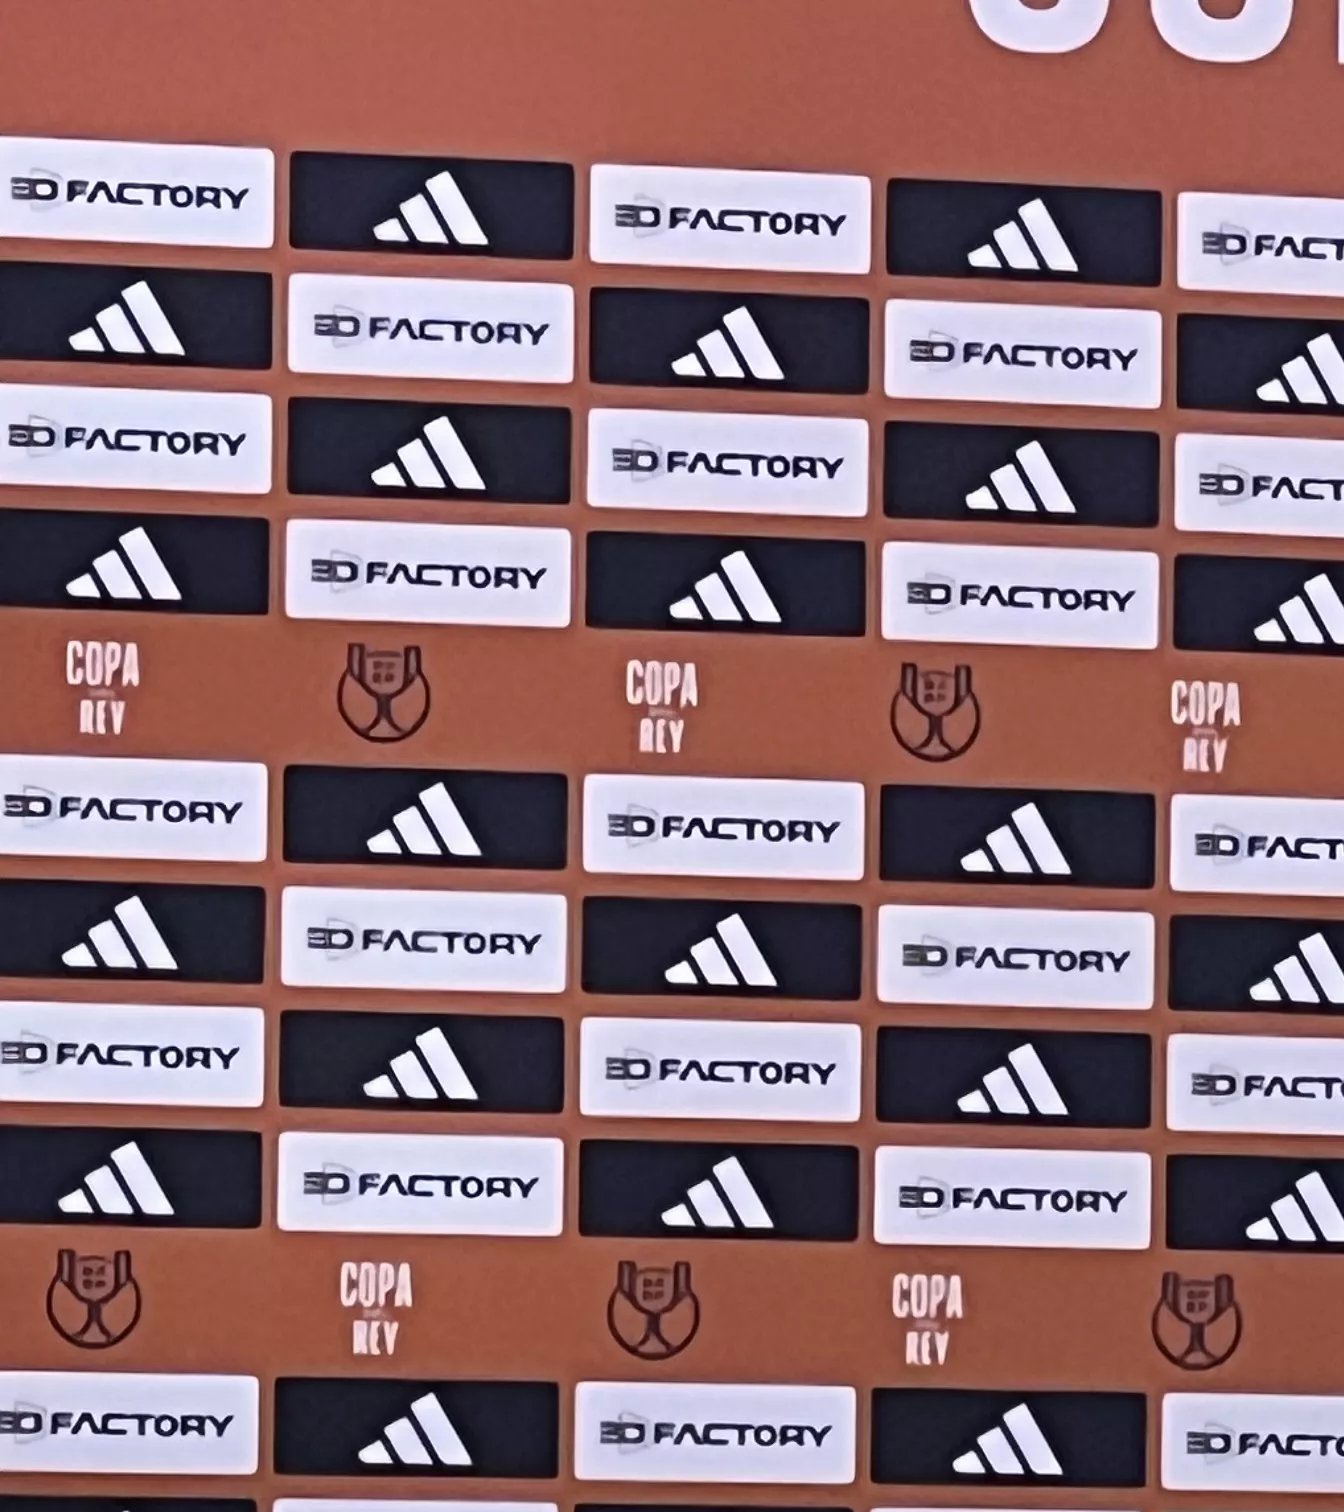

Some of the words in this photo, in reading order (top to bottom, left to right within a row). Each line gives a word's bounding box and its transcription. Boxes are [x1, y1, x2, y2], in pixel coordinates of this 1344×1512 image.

[67, 180, 249, 209] FACTORY
[669, 207, 846, 236] FACTORY
[369, 317, 549, 345] FACTORY
[963, 342, 1138, 371] FACTORY
[65, 427, 246, 456] FACTORY
[667, 451, 844, 479] FACTORY
[366, 562, 547, 589] FACTORY
[960, 584, 1136, 612] FACTORY
[67, 641, 139, 686] COPA
[627, 660, 697, 706] COPA
[1172, 680, 1240, 726] COPA
[60, 797, 243, 824] FACTORY
[662, 816, 840, 843] FACTORY
[362, 929, 542, 955] FACTORY
[956, 947, 1130, 972] FACTORY
[56, 1043, 240, 1069] FACTORY
[659, 1059, 836, 1085] FACTORY
[359, 1173, 539, 1198] FACTORY
[953, 1188, 1127, 1213] FACTORY
[341, 1262, 412, 1307] COPA
[893, 1274, 962, 1318] COPA
[50, 1412, 234, 1437] FACTORY
[654, 1423, 832, 1447] FACTORY
